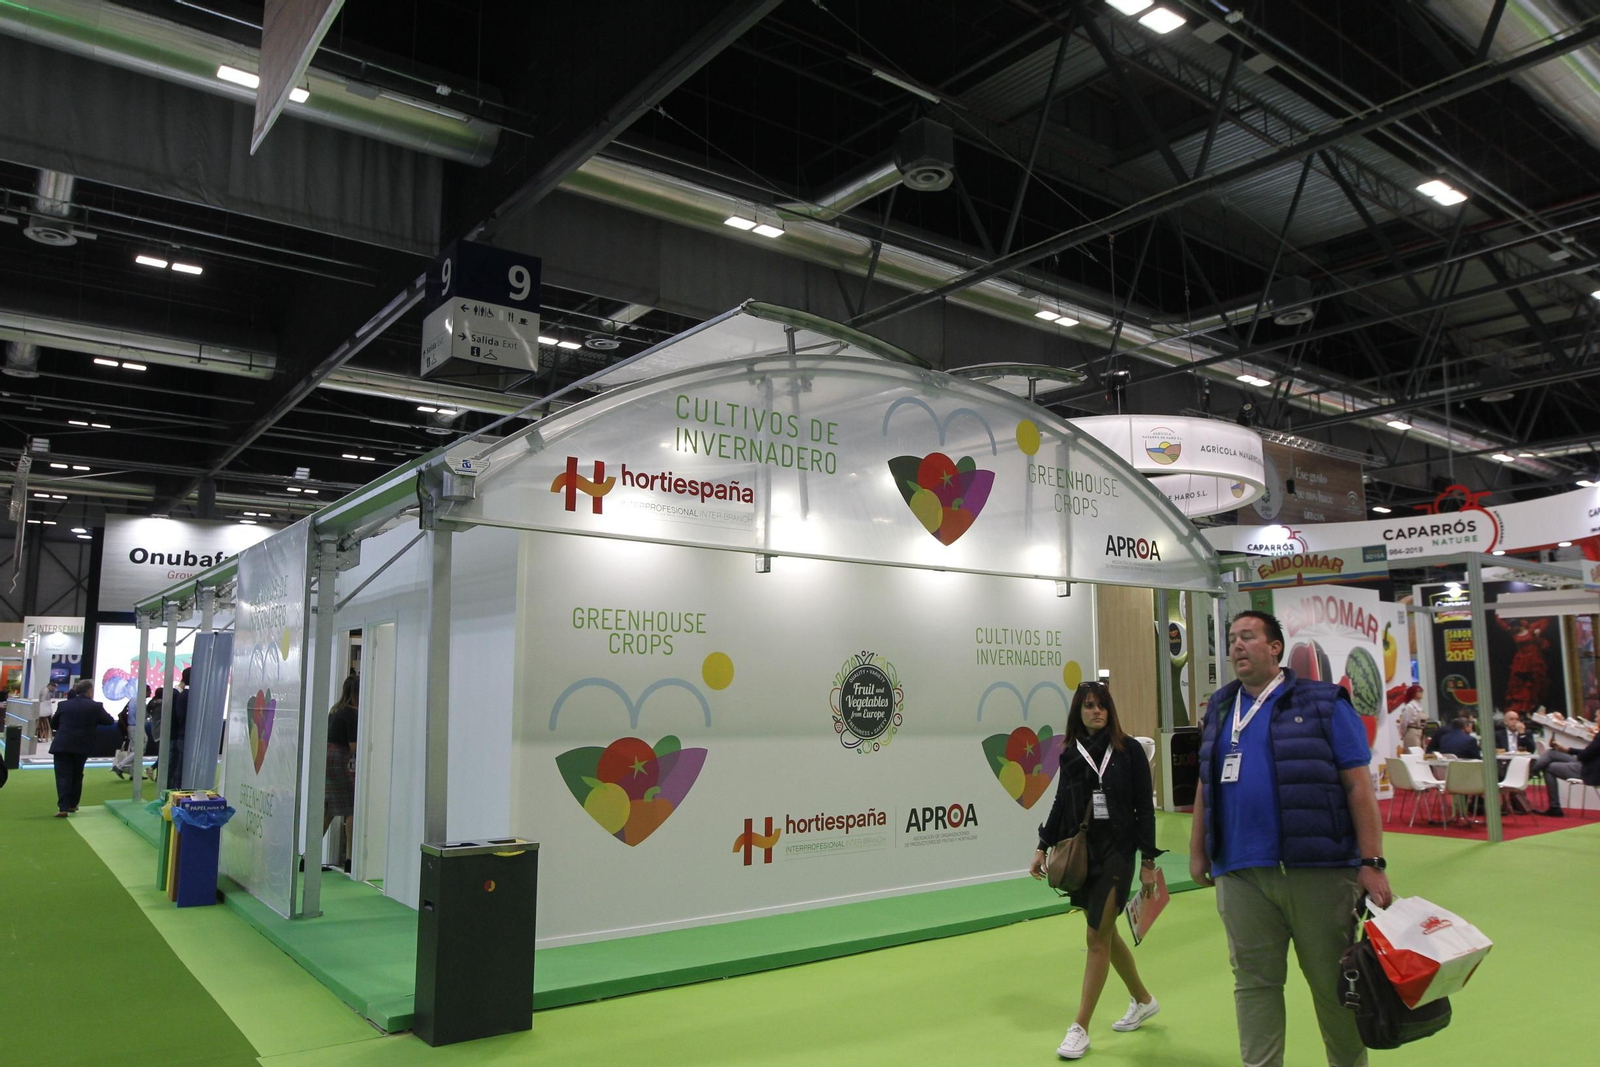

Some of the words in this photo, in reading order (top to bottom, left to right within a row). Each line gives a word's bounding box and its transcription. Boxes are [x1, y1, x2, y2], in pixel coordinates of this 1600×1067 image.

[441, 258, 452, 296] 9
[508, 265, 531, 301] 9
[471, 334, 499, 347] Salida
[502, 340, 518, 350] Exit
[675, 394, 799, 438] CULTIVOS
[810, 418, 839, 446] DE
[675, 426, 837, 475] INVERNADERO
[1200, 444, 1237, 456] AGRÍCOLA
[621, 463, 754, 503] hortiespaña
[1028, 463, 1120, 498] GREENHOUSE
[1054, 492, 1099, 518] CROPS
[1174, 493, 1195, 501] HARO
[1196, 490, 1208, 498] S.L.
[1383, 519, 1477, 541] CAPARRÓS
[1432, 535, 1478, 546] NATURE
[1105, 534, 1161, 562] APROA
[1247, 543, 1295, 551] CAPARRÓS
[1389, 547, 1424, 556] 984-2019
[1257, 554, 1344, 580] EJIDOMAR
[572, 607, 707, 634] GREENHOUSE
[608, 632, 674, 656] CROPS
[975, 627, 1040, 646] CULTIVOS
[1046, 630, 1062, 647] DE
[976, 648, 1062, 667] INVERNADERO
[1446, 649, 1475, 662] 2019
[853, 682, 875, 695] Fruit
[845, 694, 889, 711] Vegetables
[850, 710, 862, 719] from
[862, 708, 886, 720] Europe
[785, 808, 887, 835] hortiespaña
[905, 803, 979, 833] APROA
[785, 841, 845, 853] INTERPROFESIONAL
